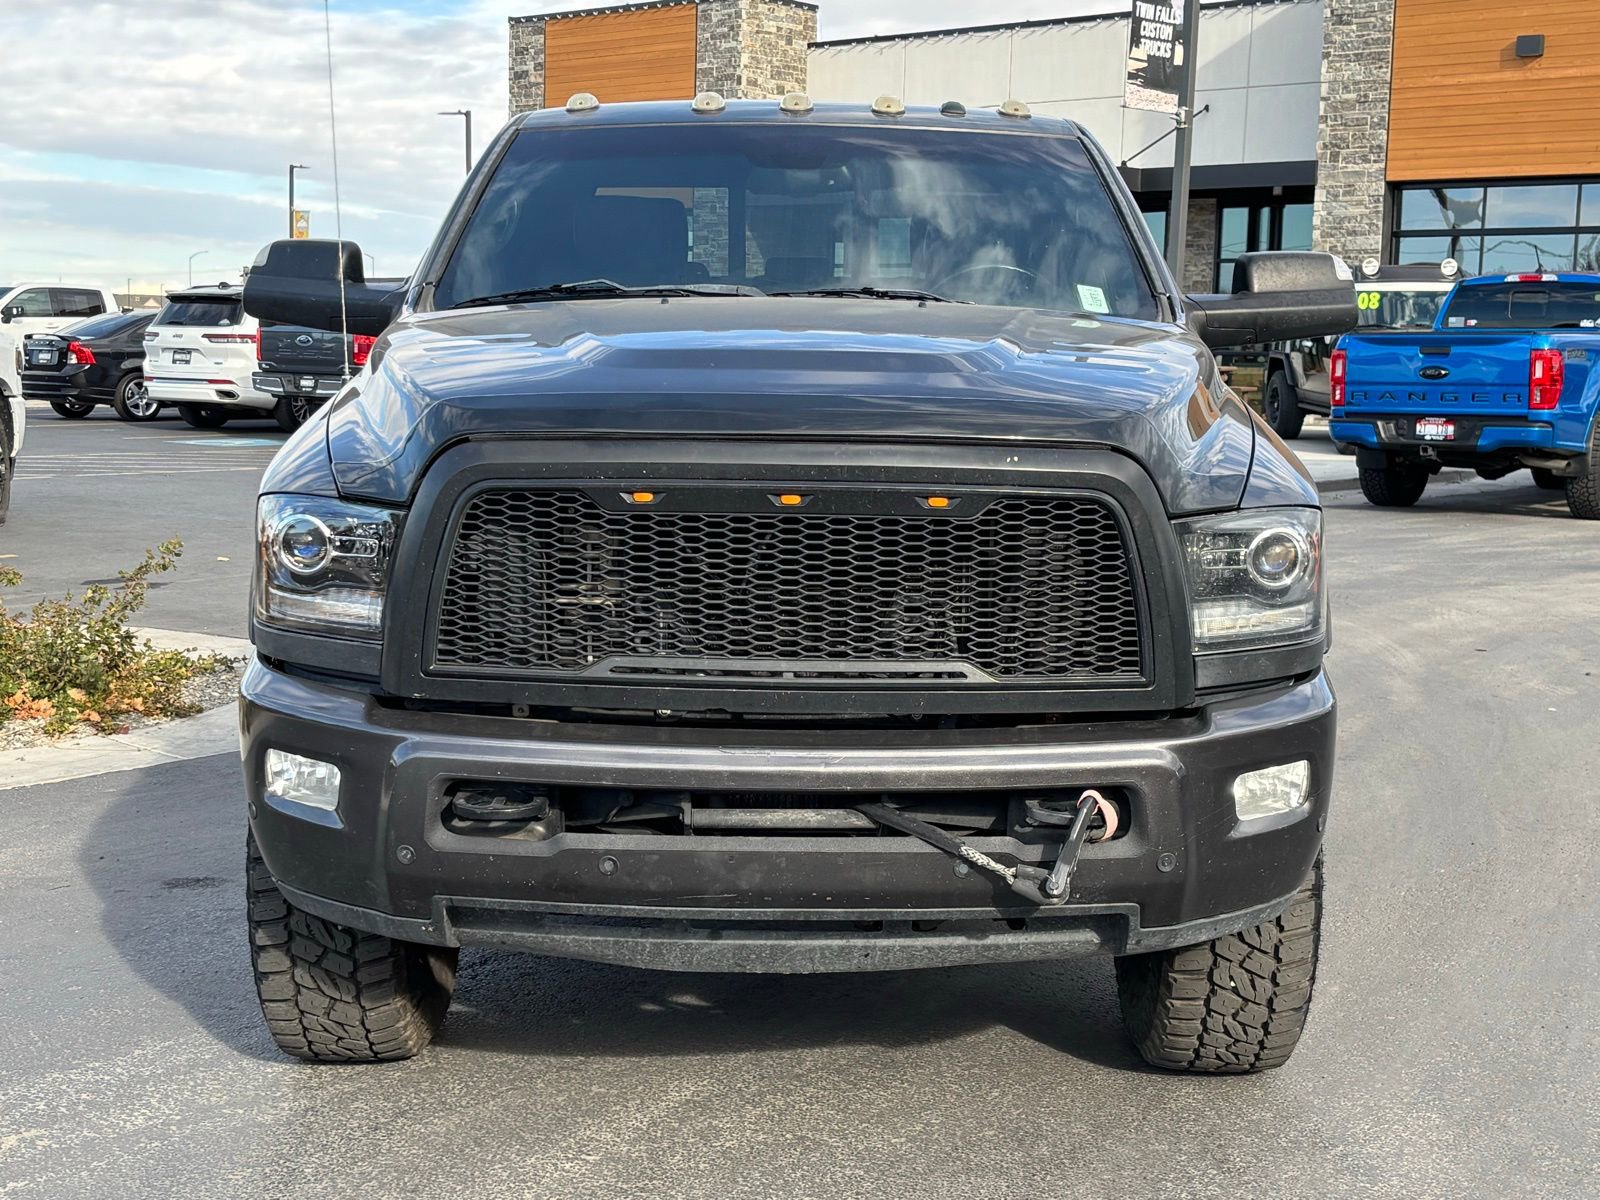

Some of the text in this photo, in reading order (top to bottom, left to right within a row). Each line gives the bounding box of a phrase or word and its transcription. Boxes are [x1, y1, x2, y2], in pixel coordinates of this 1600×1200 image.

[1136, 1, 1182, 24] TWIN FALLS
[1140, 20, 1173, 41] CUSTOM
[1139, 38, 1172, 58] TRUCKS
[1358, 292, 1380, 310] 08
[1351, 391, 1523, 404] RANGER
